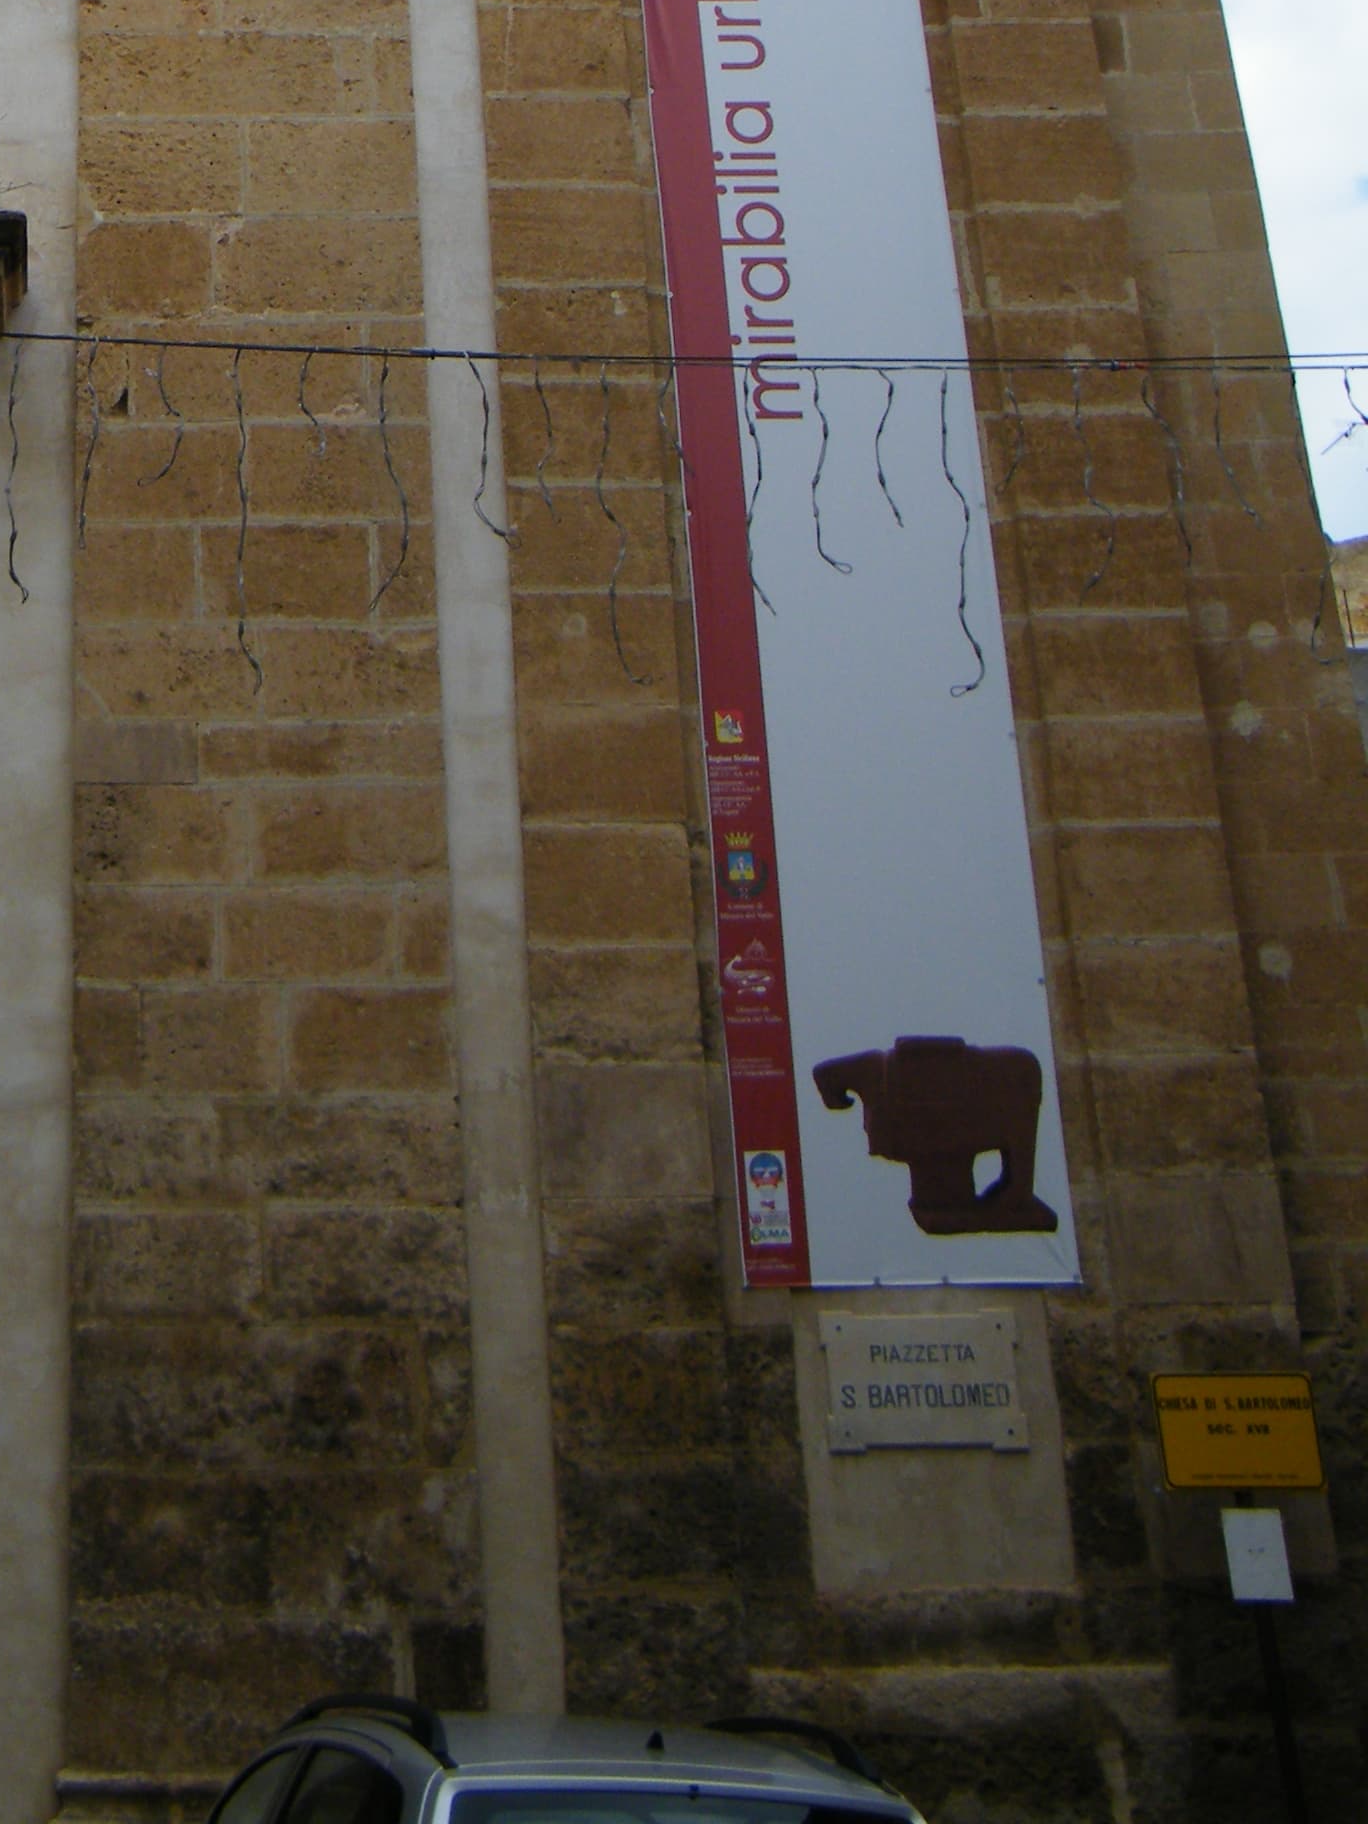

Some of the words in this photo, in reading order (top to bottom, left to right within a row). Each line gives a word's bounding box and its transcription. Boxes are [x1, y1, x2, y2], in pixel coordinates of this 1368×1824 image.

[713, 100, 804, 420] mirabilia
[869, 1344, 975, 1364] PIAZZETTA
[867, 1382, 1010, 1409] BARTOLOMEO
[1159, 1397, 1198, 1410] CHIESA
